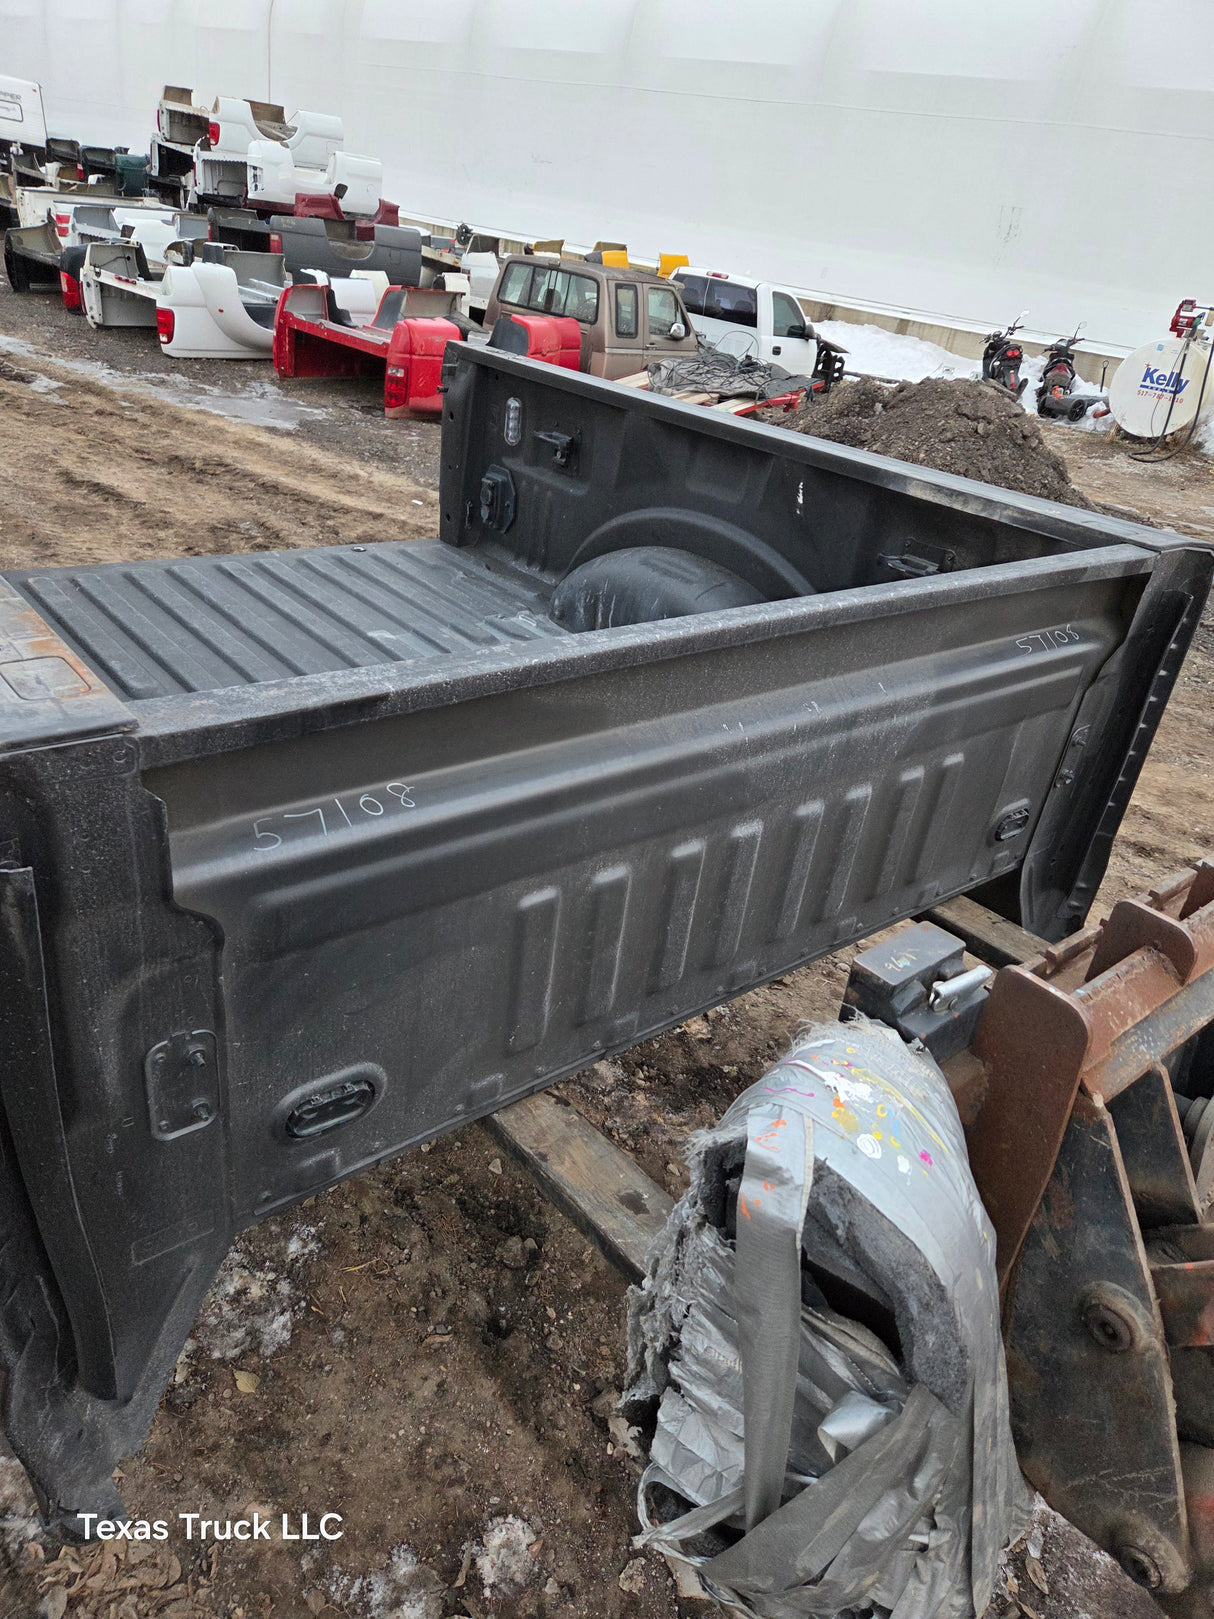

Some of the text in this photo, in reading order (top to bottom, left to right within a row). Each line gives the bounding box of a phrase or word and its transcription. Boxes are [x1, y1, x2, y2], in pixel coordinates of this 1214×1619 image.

[1142, 367, 1190, 394] Kelly
[1137, 389, 1184, 404] 517-787-110
[1015, 623, 1080, 656] 57108
[253, 782, 416, 850] 57108
